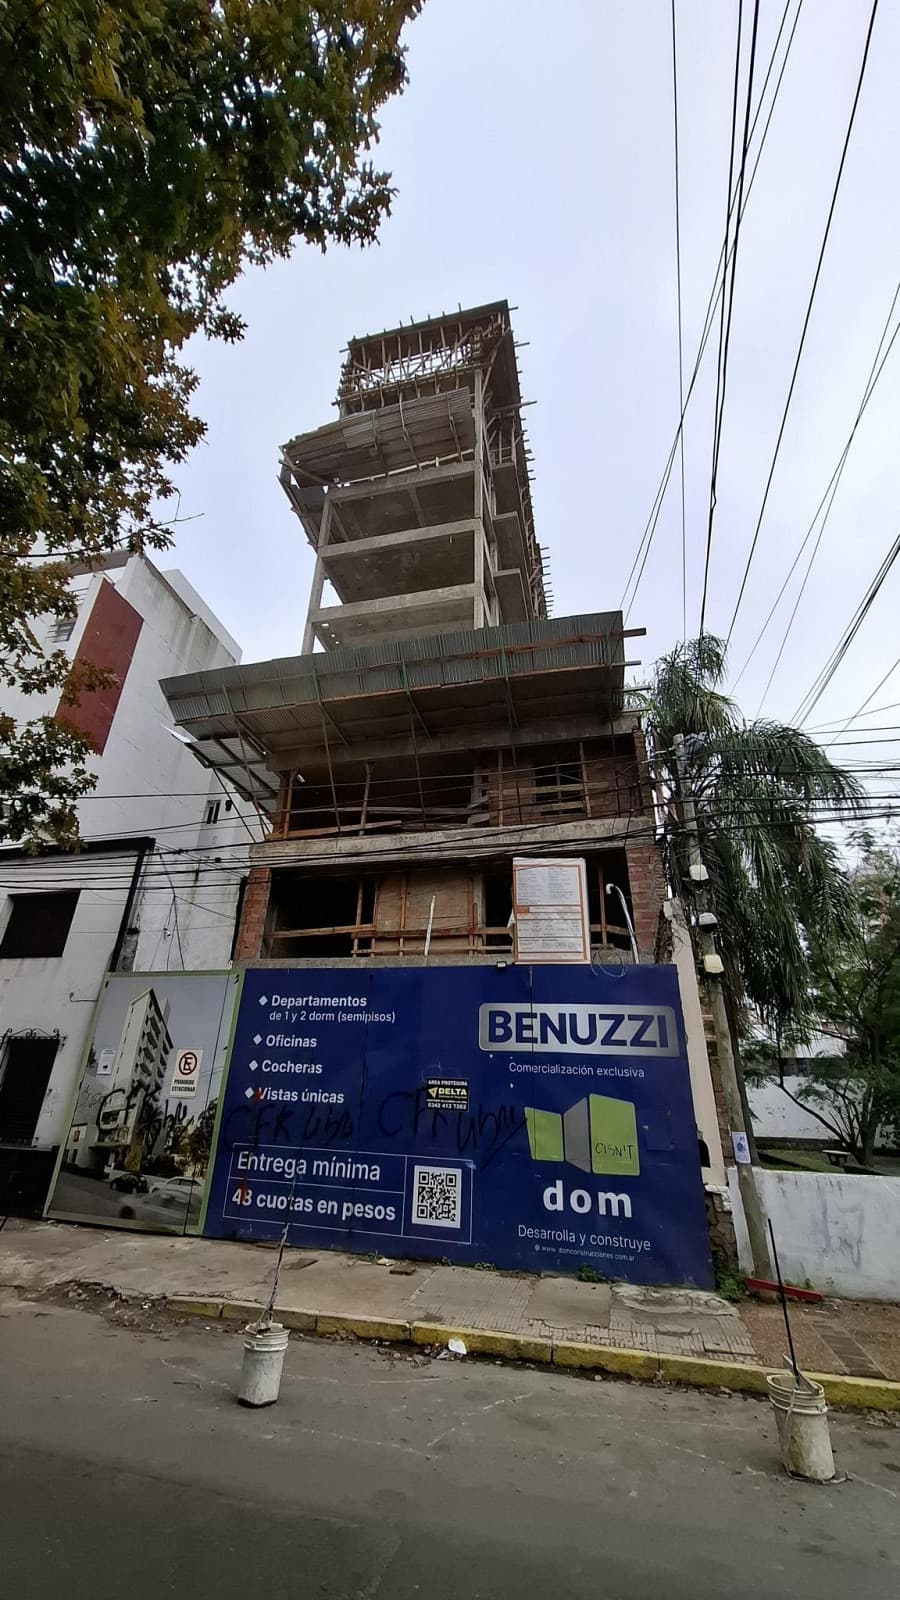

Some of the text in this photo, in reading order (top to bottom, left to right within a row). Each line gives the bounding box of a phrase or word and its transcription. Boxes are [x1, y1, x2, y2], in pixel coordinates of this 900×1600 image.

[271, 994, 368, 1009] Departamentos
[269, 1010, 396, 1024] de 1 y 2 dorm (semipisos)
[488, 1010, 669, 1048] BENUZZI
[265, 1034, 318, 1048] Oficinas
[261, 1059, 323, 1074] Cocheras
[509, 1062, 645, 1078] Comercialización exclusiva
[258, 1087, 345, 1104] Vistas únicas
[438, 1087, 467, 1096] DELTA
[237, 1150, 381, 1181] Entrega mínima
[256, 1192, 314, 1213] cuotas
[317, 1198, 338, 1215] en
[341, 1202, 397, 1221] pesos
[543, 1179, 633, 1218] dom
[518, 1224, 652, 1253] Desarrolla y construye
